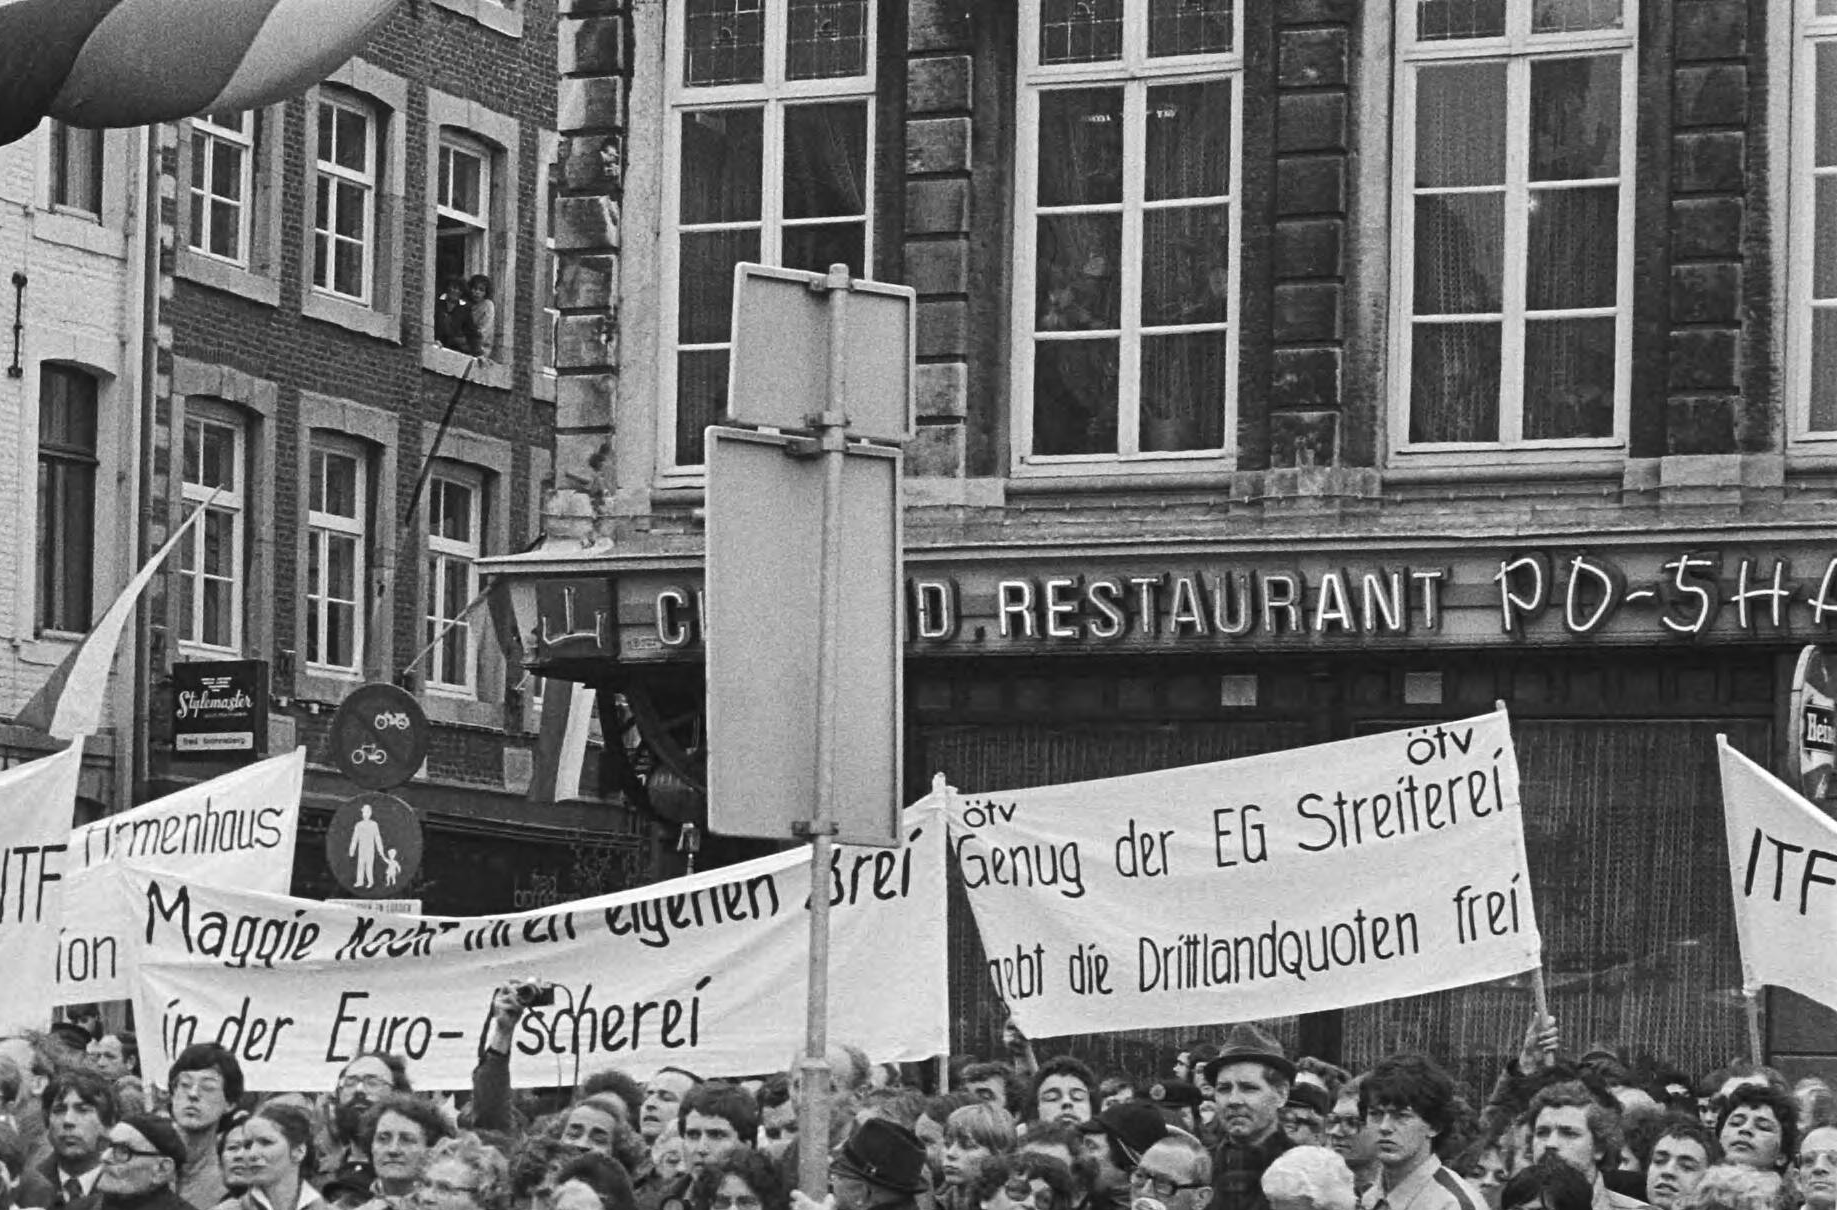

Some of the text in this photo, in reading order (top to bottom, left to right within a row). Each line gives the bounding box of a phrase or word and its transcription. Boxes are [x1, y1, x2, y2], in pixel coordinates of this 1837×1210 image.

[998, 570, 1449, 640] RESTAURANT
[176, 689, 254, 718] Stylemaster
[956, 747, 1503, 898] Genug der EG Streiterei
[1744, 827, 1837, 915] ITF
[145, 881, 321, 969] Maggie
[605, 873, 779, 948] eigenen
[1069, 943, 1113, 995] die
[1453, 872, 1520, 944] frei
[218, 997, 294, 1062] der
